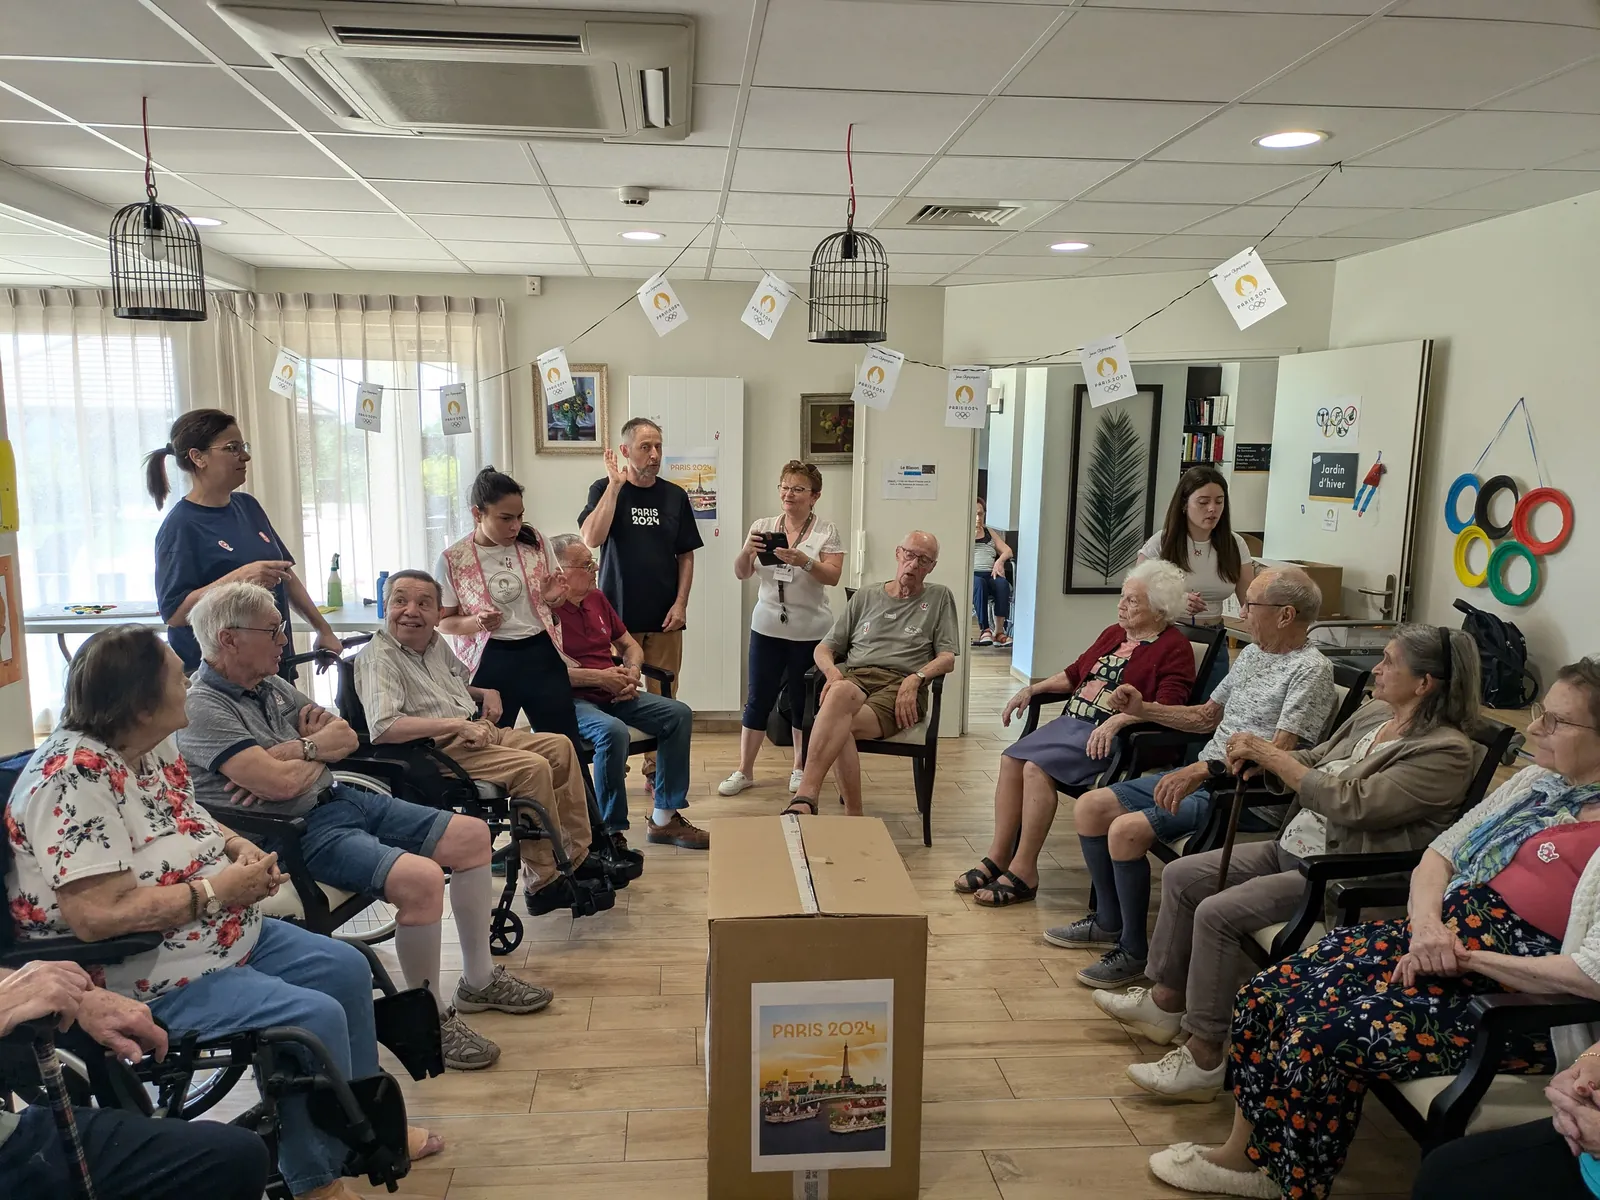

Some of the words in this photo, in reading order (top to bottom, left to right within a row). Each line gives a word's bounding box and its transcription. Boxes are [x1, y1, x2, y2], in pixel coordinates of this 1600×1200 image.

[1236, 297, 1254, 310] PARIS
[1254, 287, 1272, 298] 2024
[1094, 378, 1111, 388] PARIS
[1112, 374, 1128, 382] 2024
[1321, 464, 1345, 474] Jardin
[1318, 477, 1346, 488] d'hiver
[631, 507, 658, 517] PARIS
[632, 516, 660, 526] 2024
[772, 1022, 823, 1038] PARIS
[828, 1021, 875, 1036] 2024
